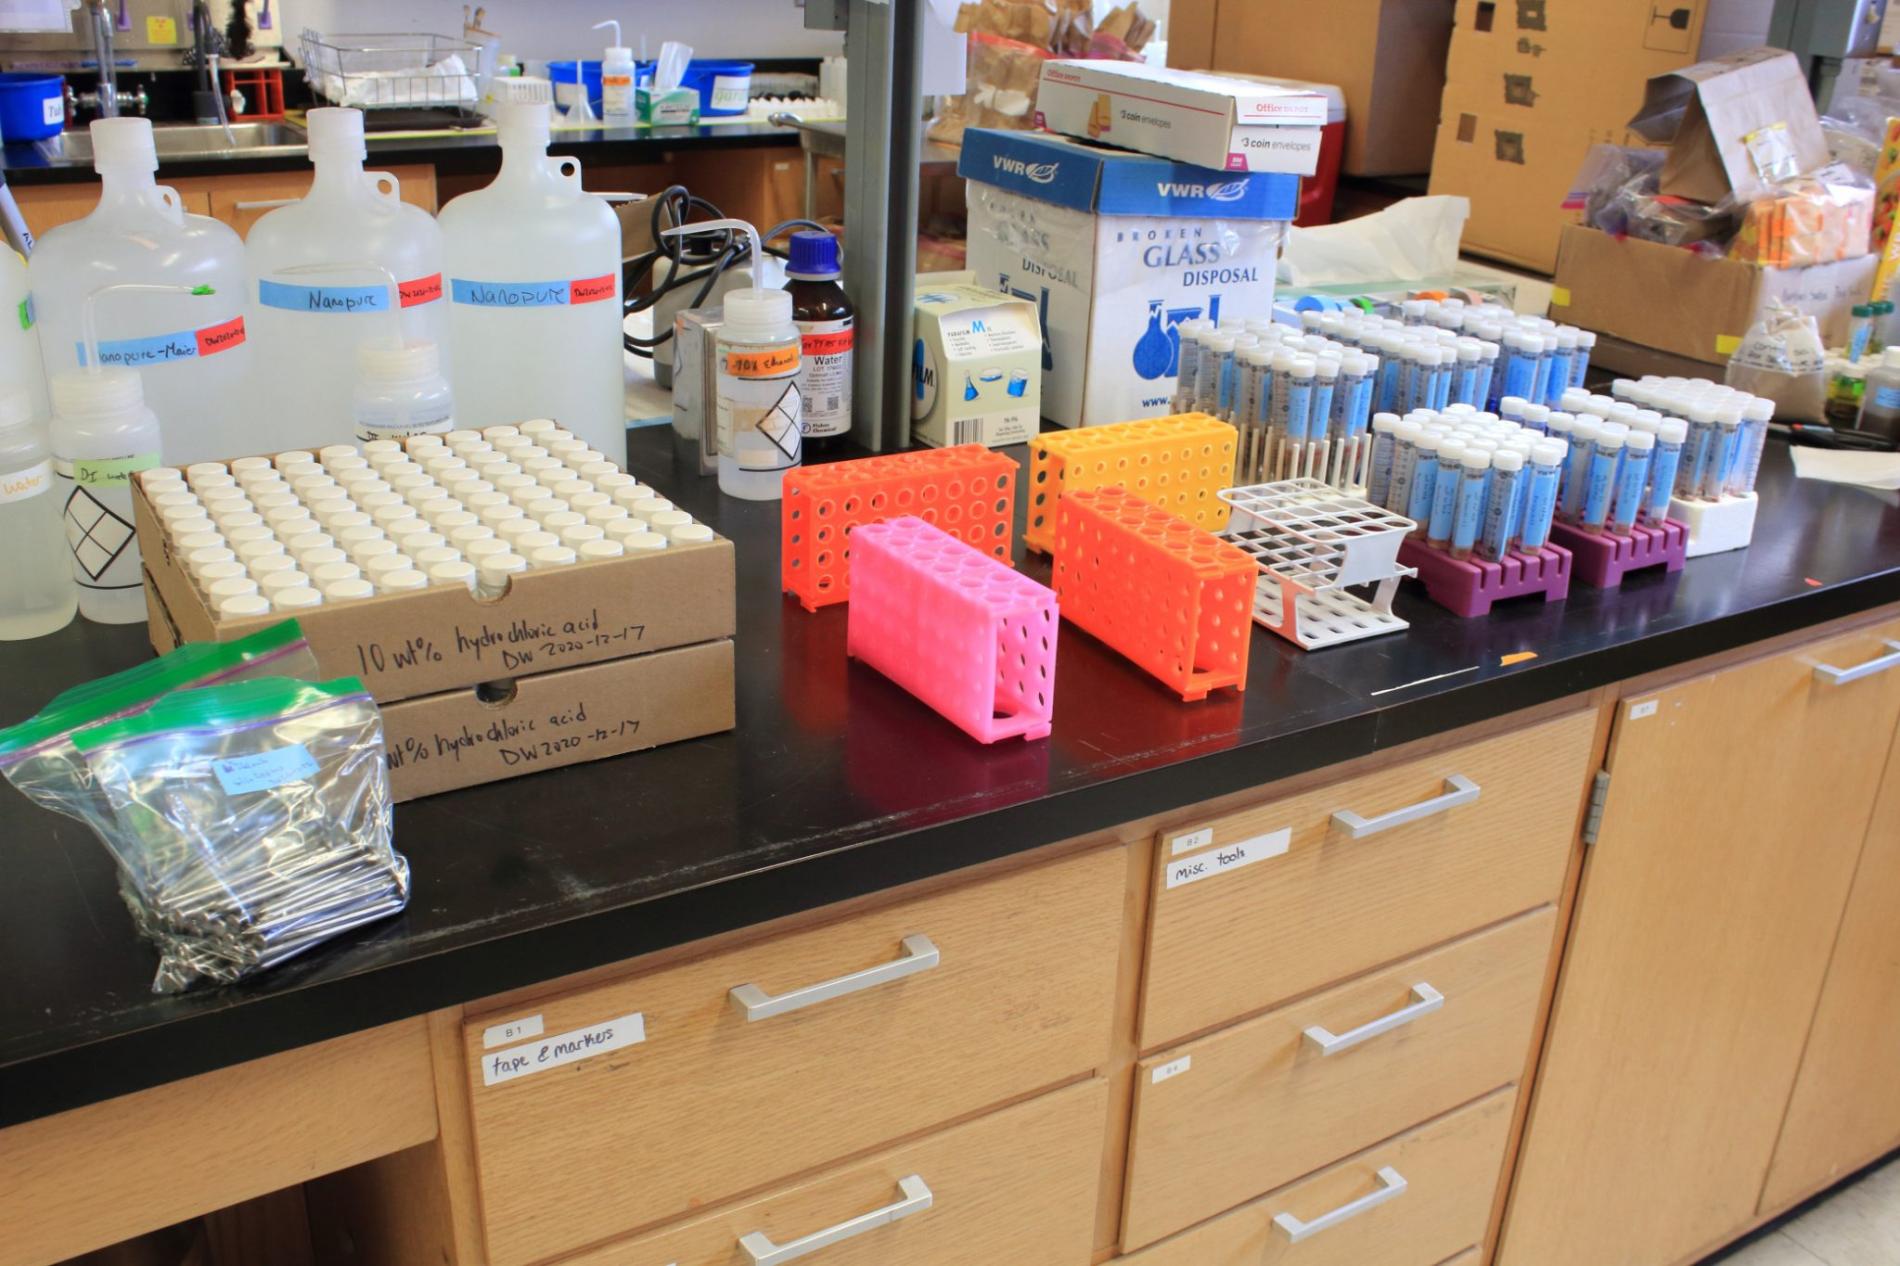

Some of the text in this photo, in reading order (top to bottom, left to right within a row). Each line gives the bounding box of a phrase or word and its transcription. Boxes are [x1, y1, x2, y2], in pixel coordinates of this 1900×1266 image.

[1250, 138, 1271, 149] coin
[1271, 140, 1311, 151] envelopes
[993, 154, 1025, 177] VWR
[1158, 183, 1204, 198] VWR
[1116, 227, 1202, 243] BROKEN
[1143, 242, 1221, 268] GLASS
[1183, 267, 1258, 287] DISPOSAL
[308, 290, 377, 312] Nanopure
[471, 285, 565, 305] Nanopure
[814, 355, 842, 366] Water
[357, 609, 599, 675] 10 wt% hydrochloric acid
[502, 625, 645, 670] DW 2020-12-17
[435, 719, 535, 762] hydrochloric
[549, 702, 587, 727] acid
[1175, 847, 1245, 881] misc. tools
[493, 1054, 530, 1077] tape
[554, 1028, 613, 1058] markers
